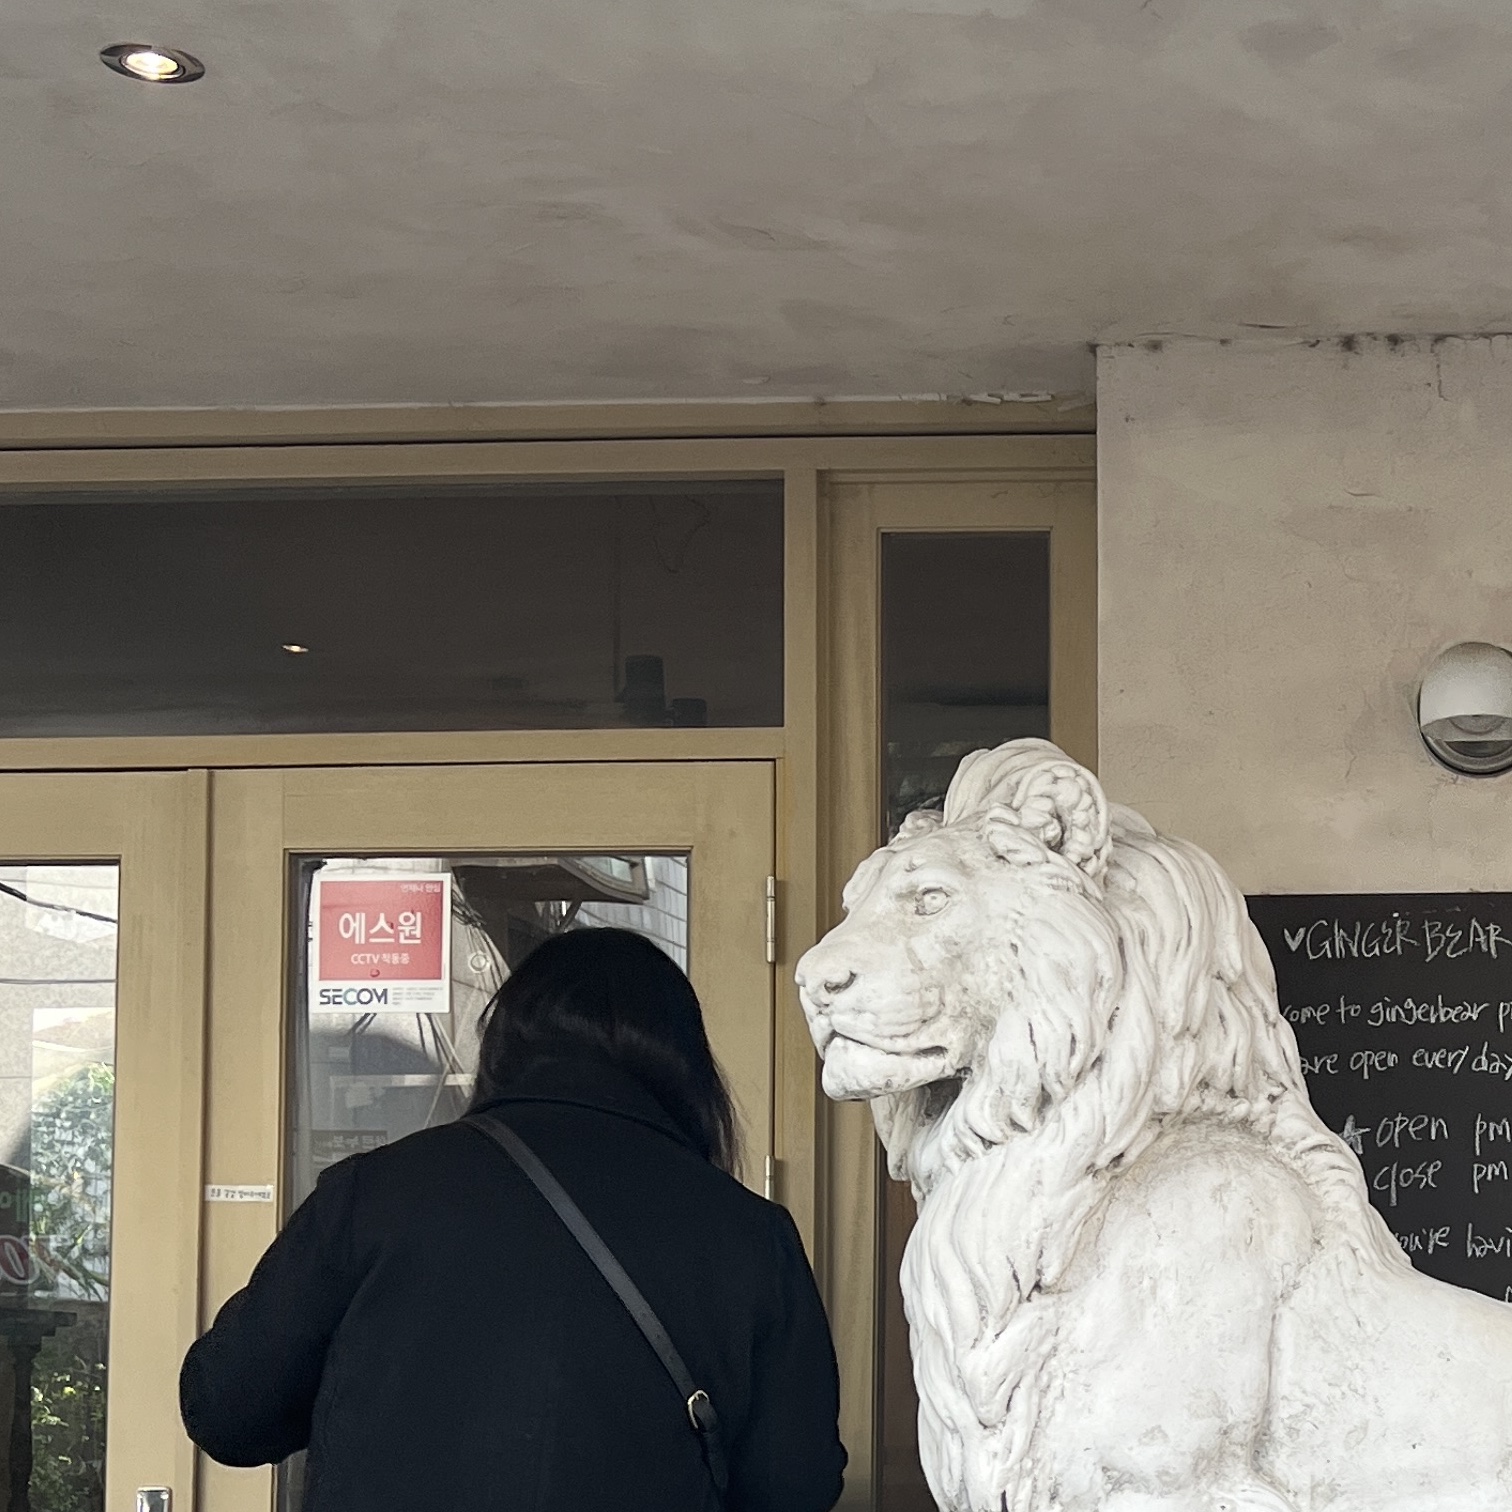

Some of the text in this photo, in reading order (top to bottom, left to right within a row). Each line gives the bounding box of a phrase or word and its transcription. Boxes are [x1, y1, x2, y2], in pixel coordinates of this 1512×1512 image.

[338, 911, 422, 944] 에스원
[1306, 918, 1419, 960] GINGER
[1423, 918, 1512, 962] BEAR
[351, 953, 380, 964] CCTV
[319, 988, 388, 1005] SECOM
[1336, 995, 1361, 1024] to
[1367, 994, 1490, 1026] gingerbear
[1300, 1053, 1339, 1074] are
[1350, 1051, 1399, 1079] open
[1376, 1112, 1448, 1148] open
[1373, 1160, 1442, 1207] close
[1473, 1160, 1509, 1194] pm
